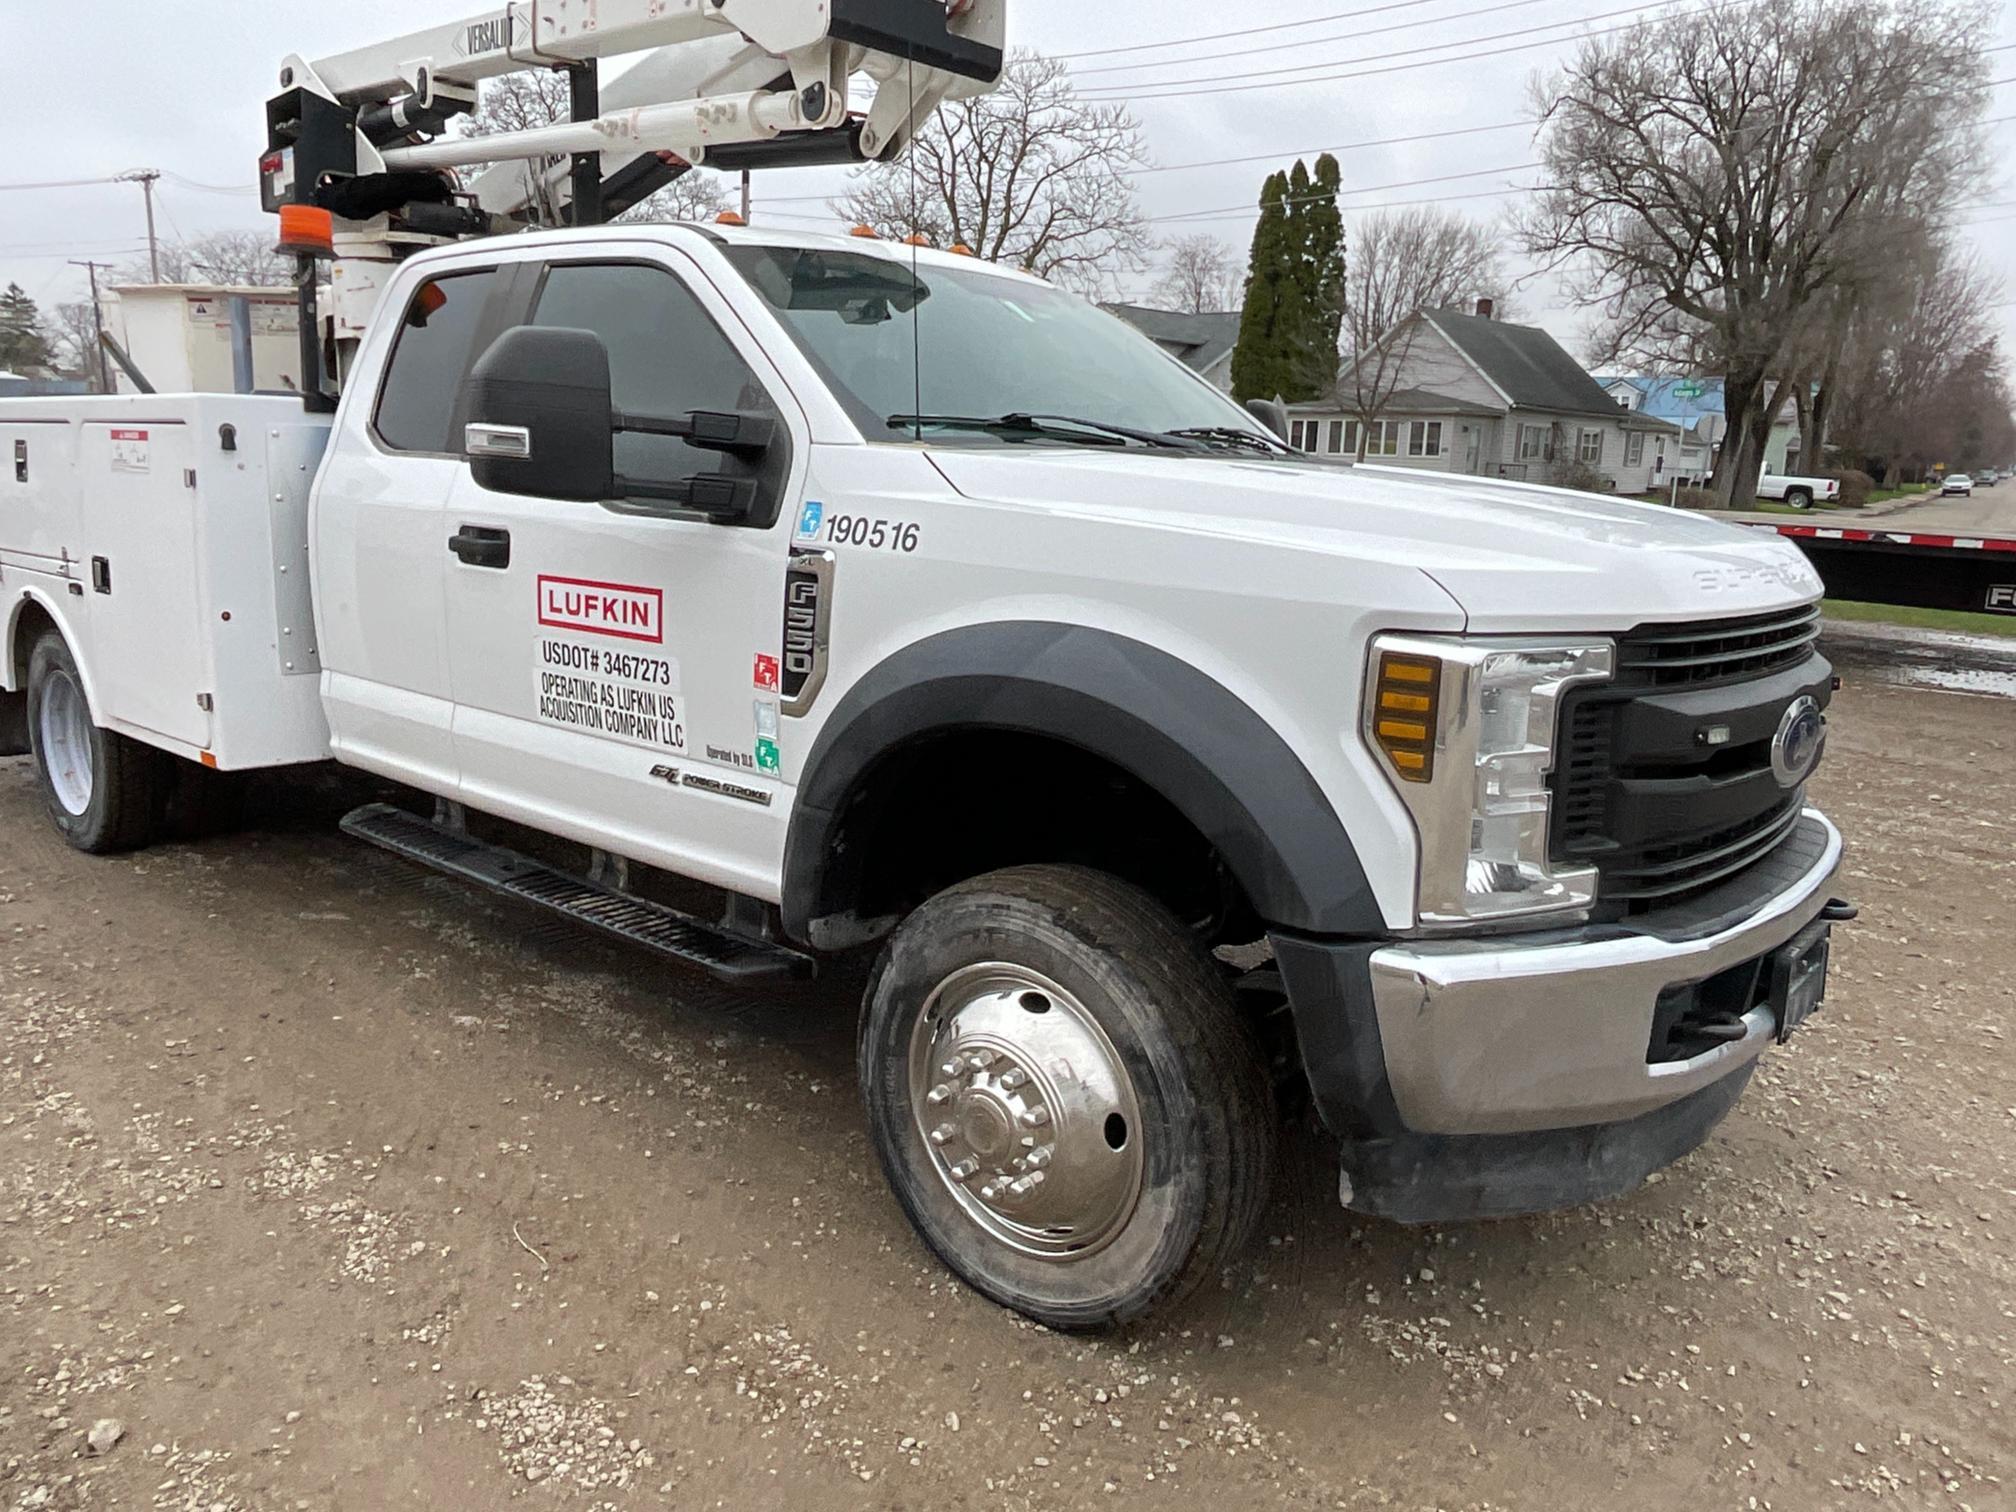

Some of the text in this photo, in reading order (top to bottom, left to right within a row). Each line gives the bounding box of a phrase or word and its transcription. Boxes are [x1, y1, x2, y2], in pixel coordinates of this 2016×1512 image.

[826, 514, 920, 553] 190516
[800, 557, 814, 566] XL
[549, 589, 649, 627] LUFKIN
[1990, 587, 2016, 606] F
[543, 640, 670, 685] USDOT# 3467273
[541, 671, 675, 721] OPERATING AS LUFKIN US
[540, 695, 684, 748] ACQUISITION COMPANY LLC
